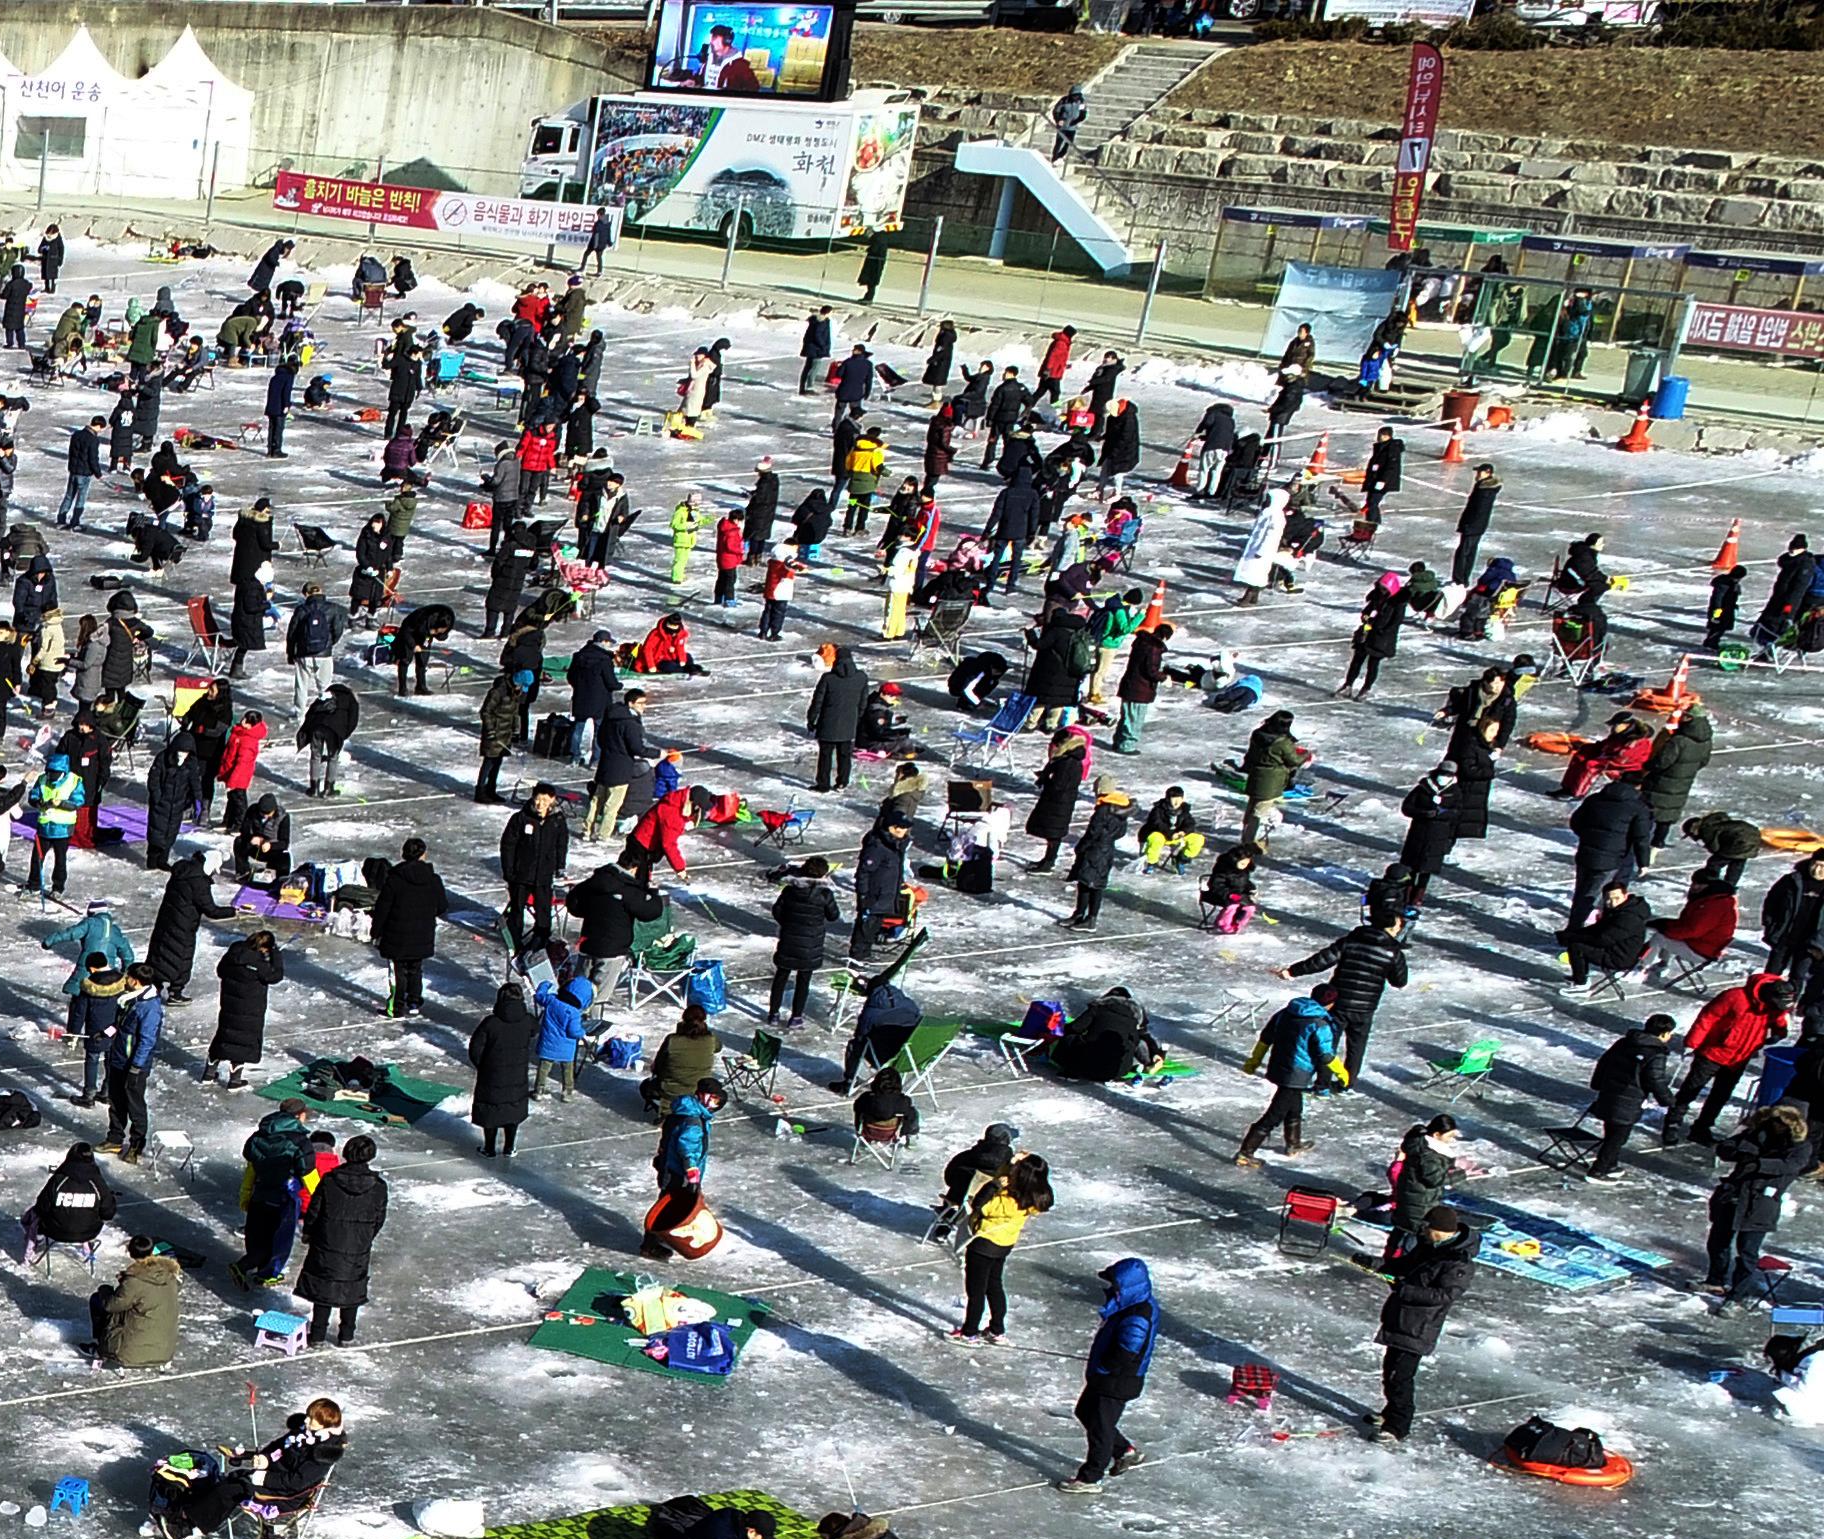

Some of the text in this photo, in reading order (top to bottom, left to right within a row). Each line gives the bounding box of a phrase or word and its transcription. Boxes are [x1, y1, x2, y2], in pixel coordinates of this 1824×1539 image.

[20, 80, 102, 102] 산천어 운송
[746, 133, 767, 143] DMZ
[792, 150, 836, 176] 화천
[346, 185, 385, 209] 바늘은
[389, 191, 422, 214] 반칙!
[473, 201, 598, 234] 음식물과 화기 반입금
